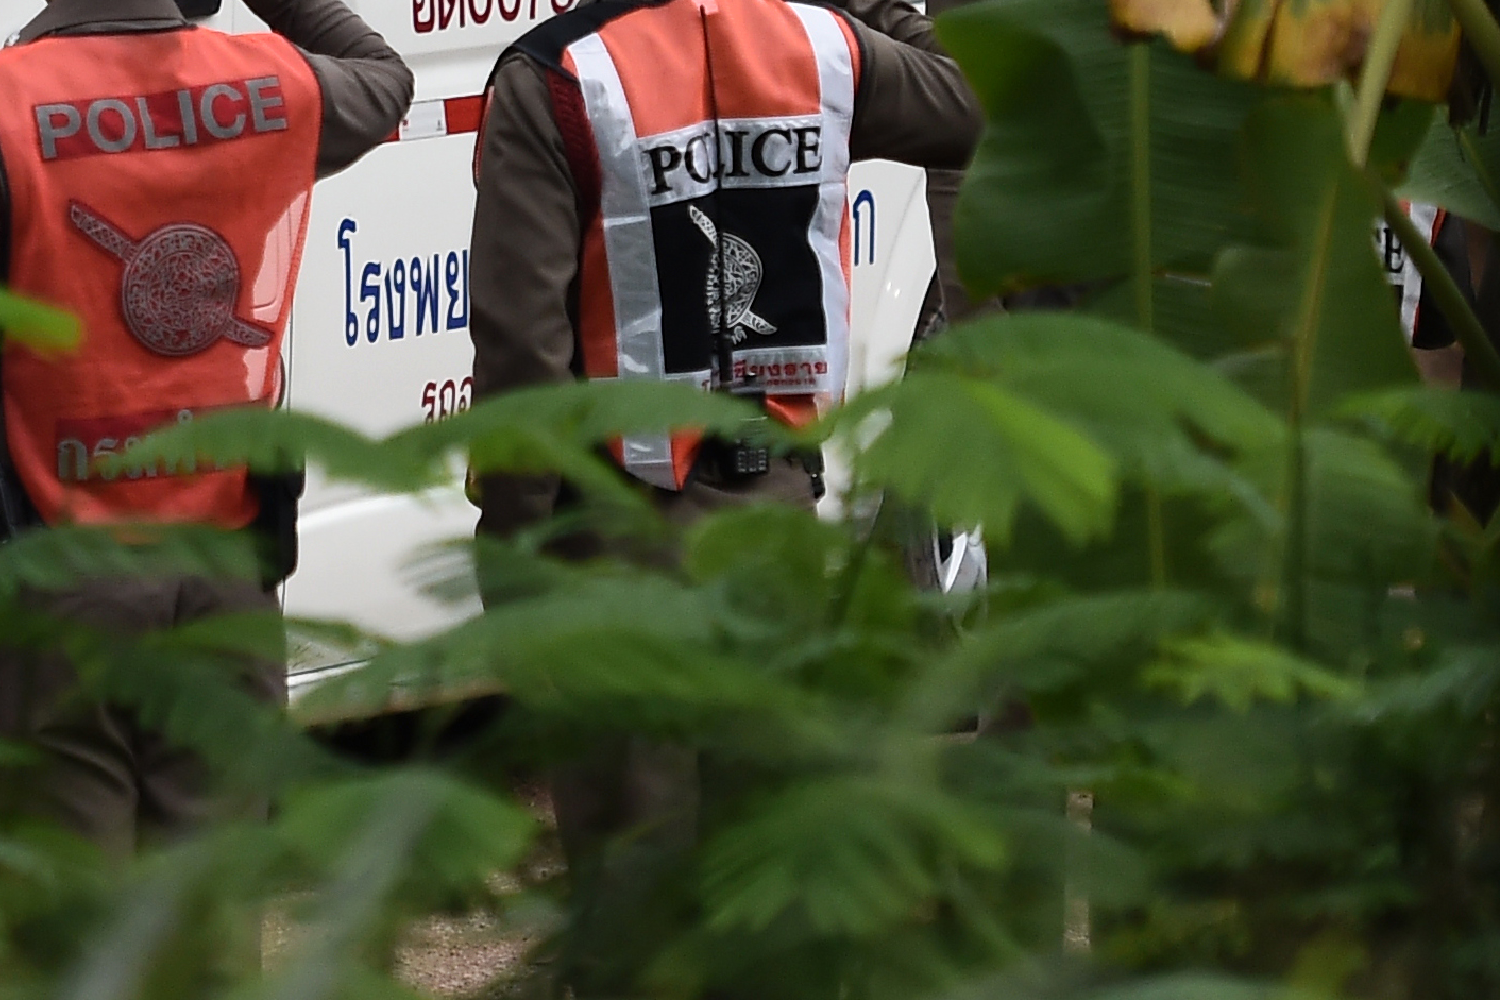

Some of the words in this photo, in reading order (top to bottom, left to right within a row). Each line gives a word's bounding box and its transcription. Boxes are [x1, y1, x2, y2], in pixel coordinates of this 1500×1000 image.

[38, 75, 288, 159] POLICE
[644, 127, 823, 196] POICE
[337, 217, 469, 346] โรงพย
